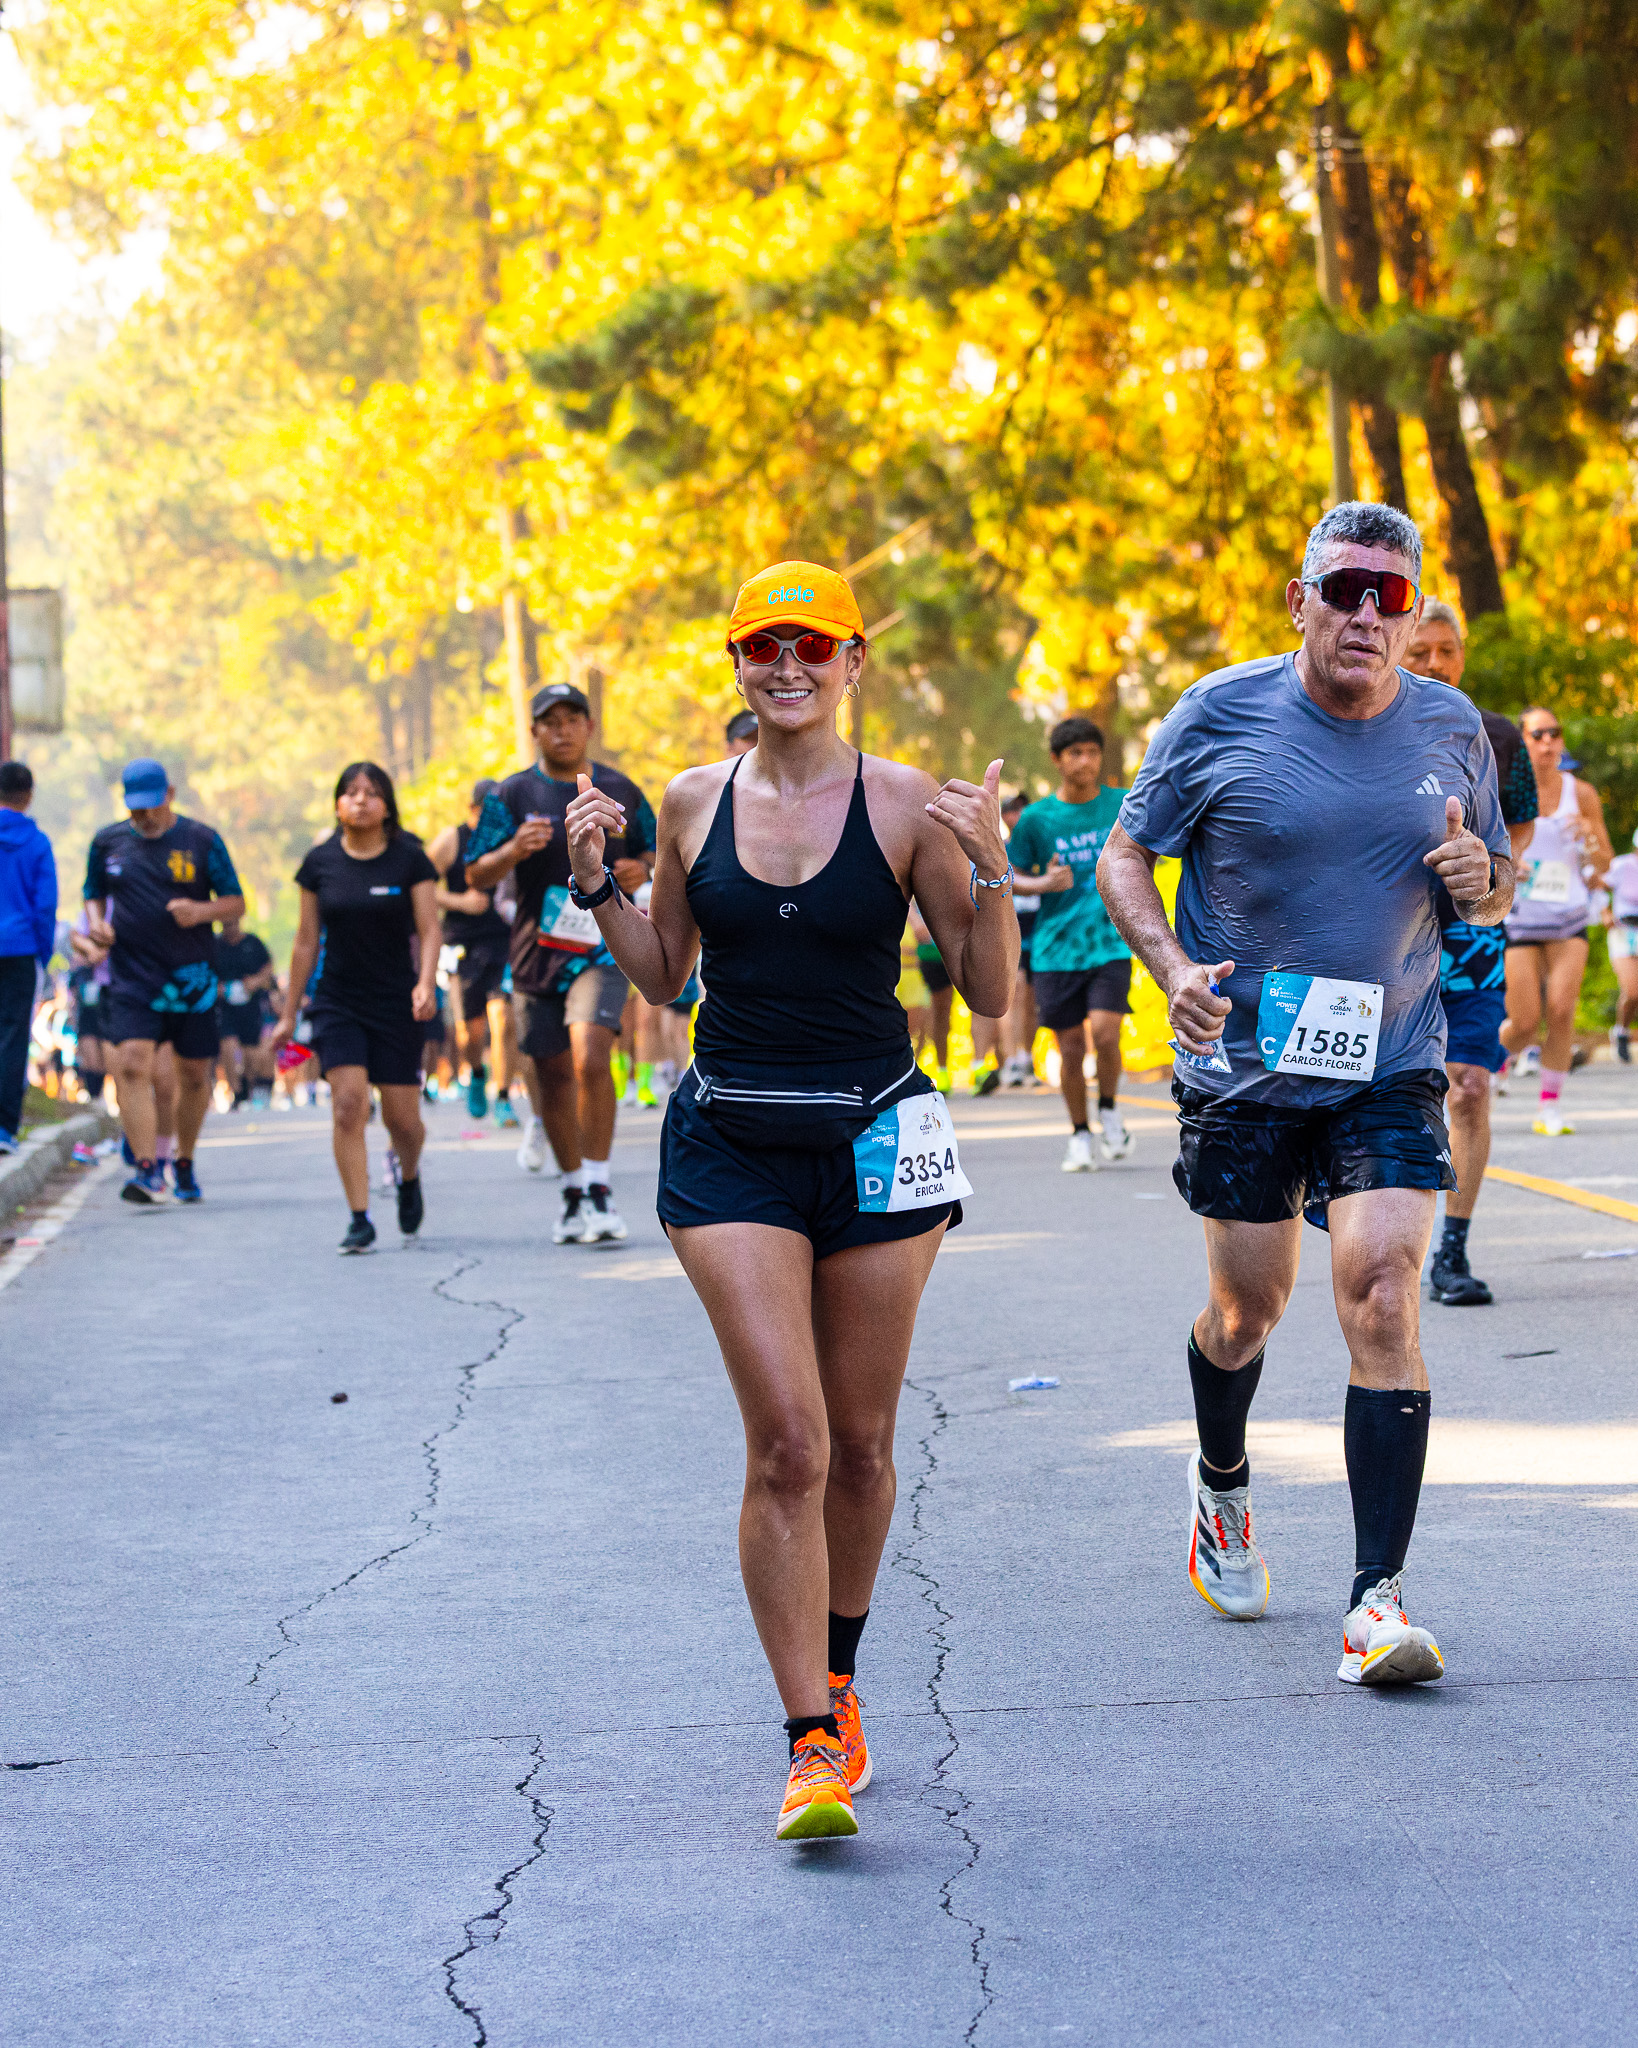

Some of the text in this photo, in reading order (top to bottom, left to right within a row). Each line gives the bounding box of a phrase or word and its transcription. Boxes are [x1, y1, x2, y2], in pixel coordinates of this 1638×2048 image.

[768, 585, 814, 605] ciele
[1261, 1036, 1277, 1055] C
[1296, 1026, 1369, 1059] 1585
[1283, 1053, 1362, 1071] CARLOS FLORES
[872, 1134, 895, 1143] POWER
[898, 1147, 955, 1185] 3354
[864, 1176, 884, 1196] D
[915, 1182, 945, 1198] ERICKA
